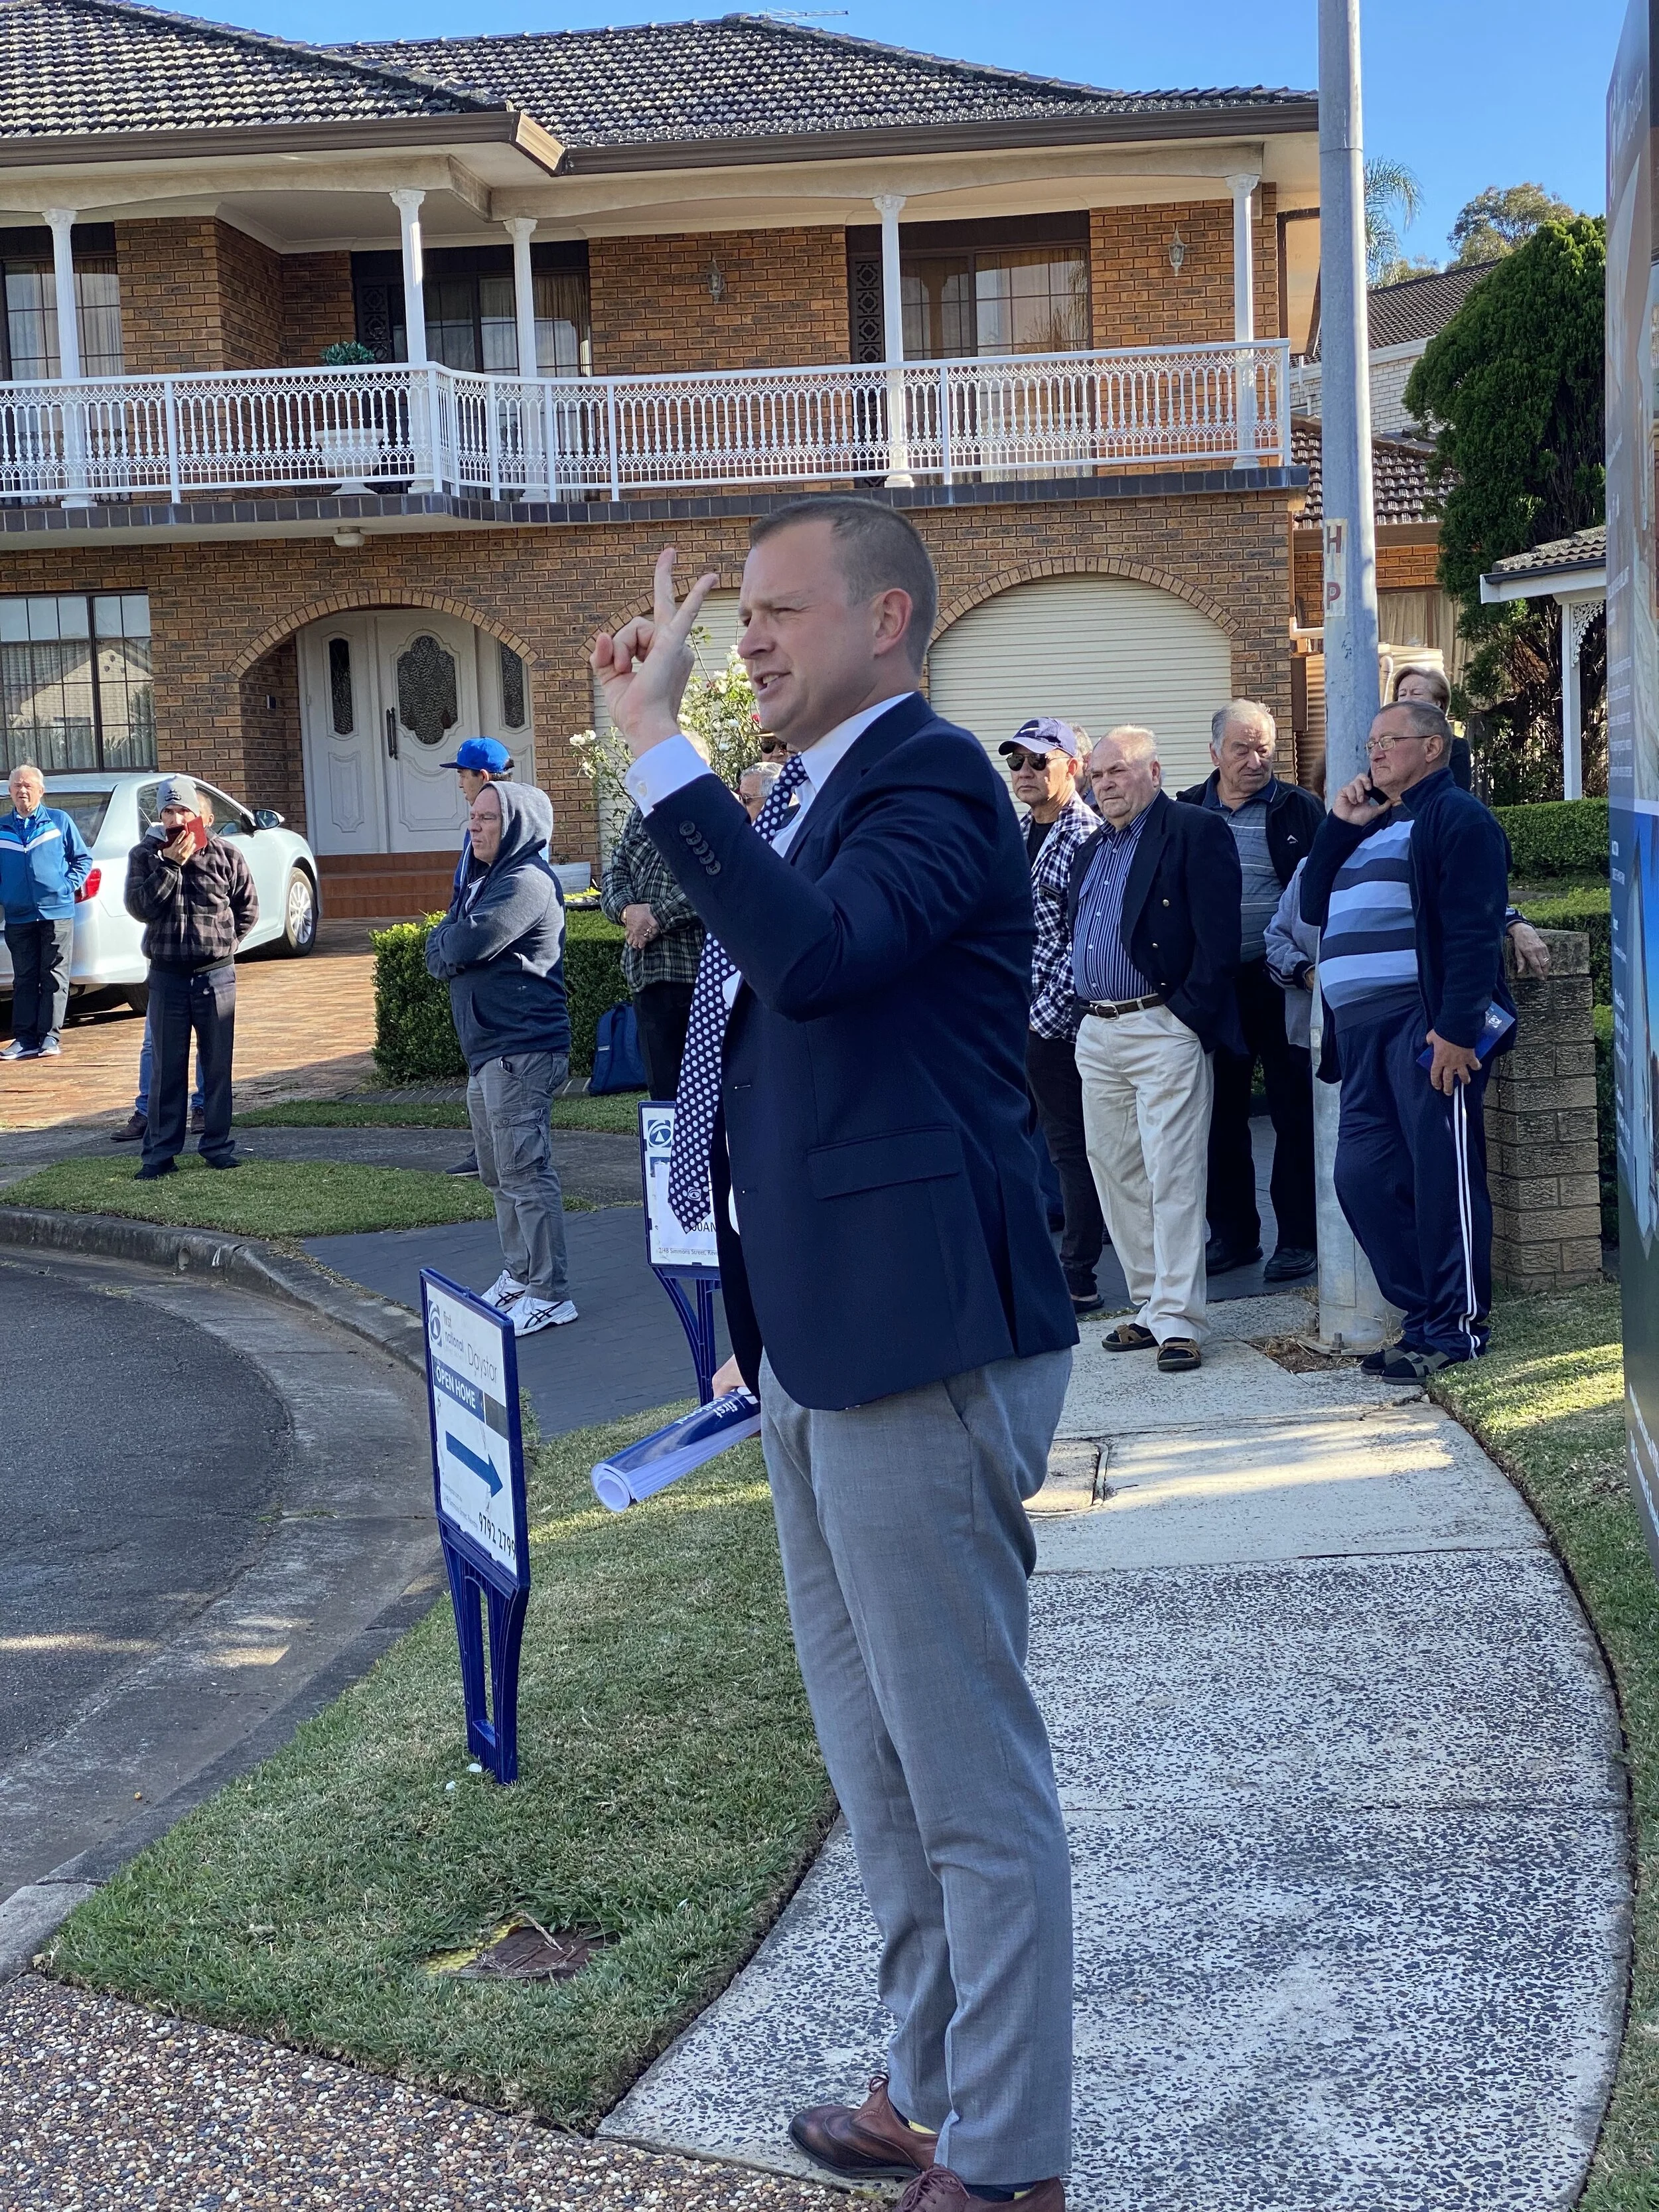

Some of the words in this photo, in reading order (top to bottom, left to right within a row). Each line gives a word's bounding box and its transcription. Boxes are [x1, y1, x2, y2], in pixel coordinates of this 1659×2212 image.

[1327, 525, 1342, 553] H
[1327, 581, 1341, 610] P
[445, 1331, 464, 1353] national
[468, 1343, 497, 1383] Daystar
[436, 1365, 455, 1393] OPEN
[455, 1378, 476, 1410] HOME
[674, 1397, 725, 1425] national
[713, 1401, 738, 1418] first
[478, 1512, 496, 1544] 9792
[498, 1528, 516, 1560] 2799
